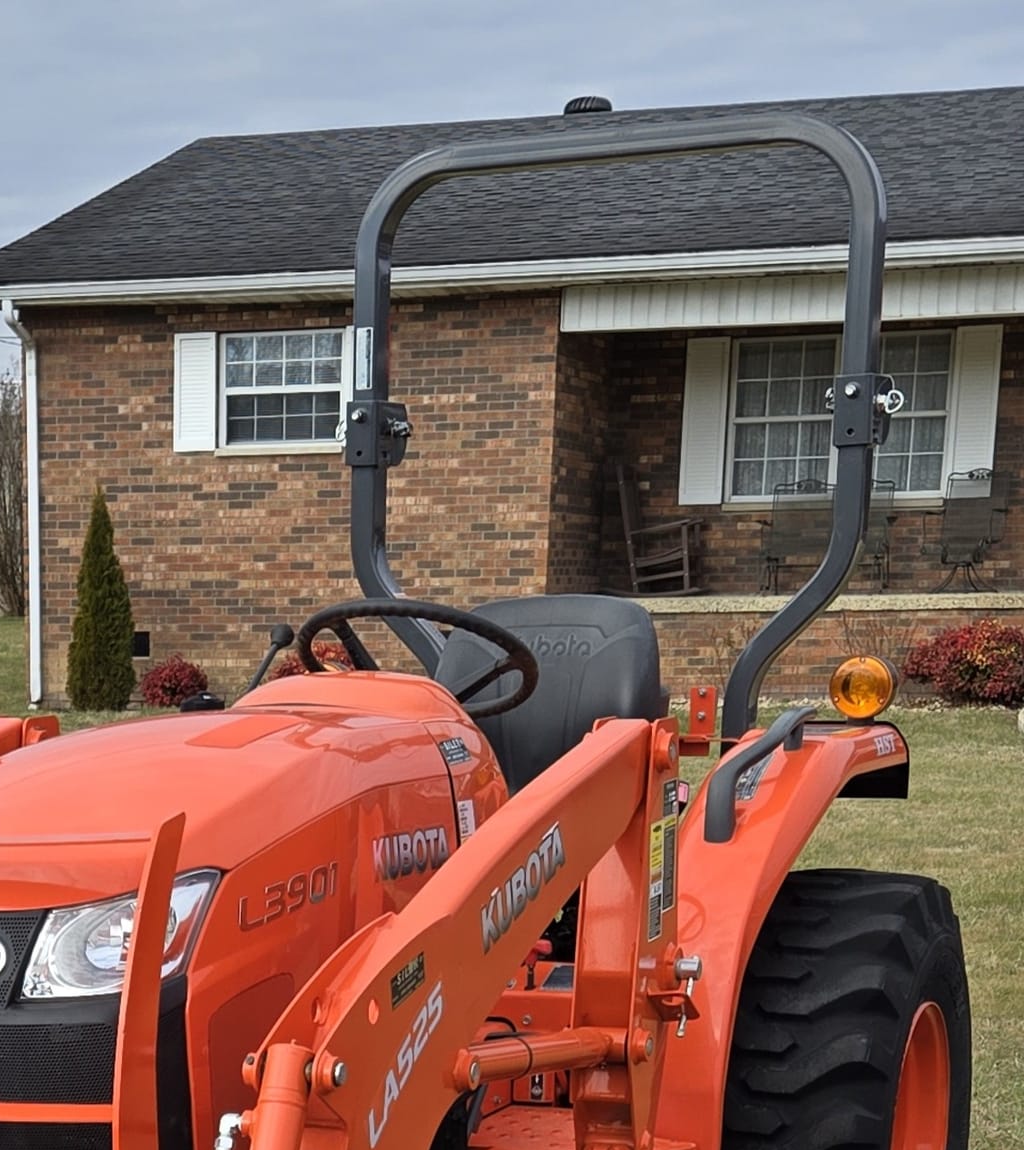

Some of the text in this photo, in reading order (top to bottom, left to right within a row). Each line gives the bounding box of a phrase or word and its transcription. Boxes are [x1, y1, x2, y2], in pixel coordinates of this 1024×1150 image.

[874, 733, 896, 756] HST
[372, 827, 450, 883] KUBOTA
[480, 821, 566, 955] KUBOTA
[238, 861, 339, 932] L3901
[367, 981, 445, 1150] LA525
